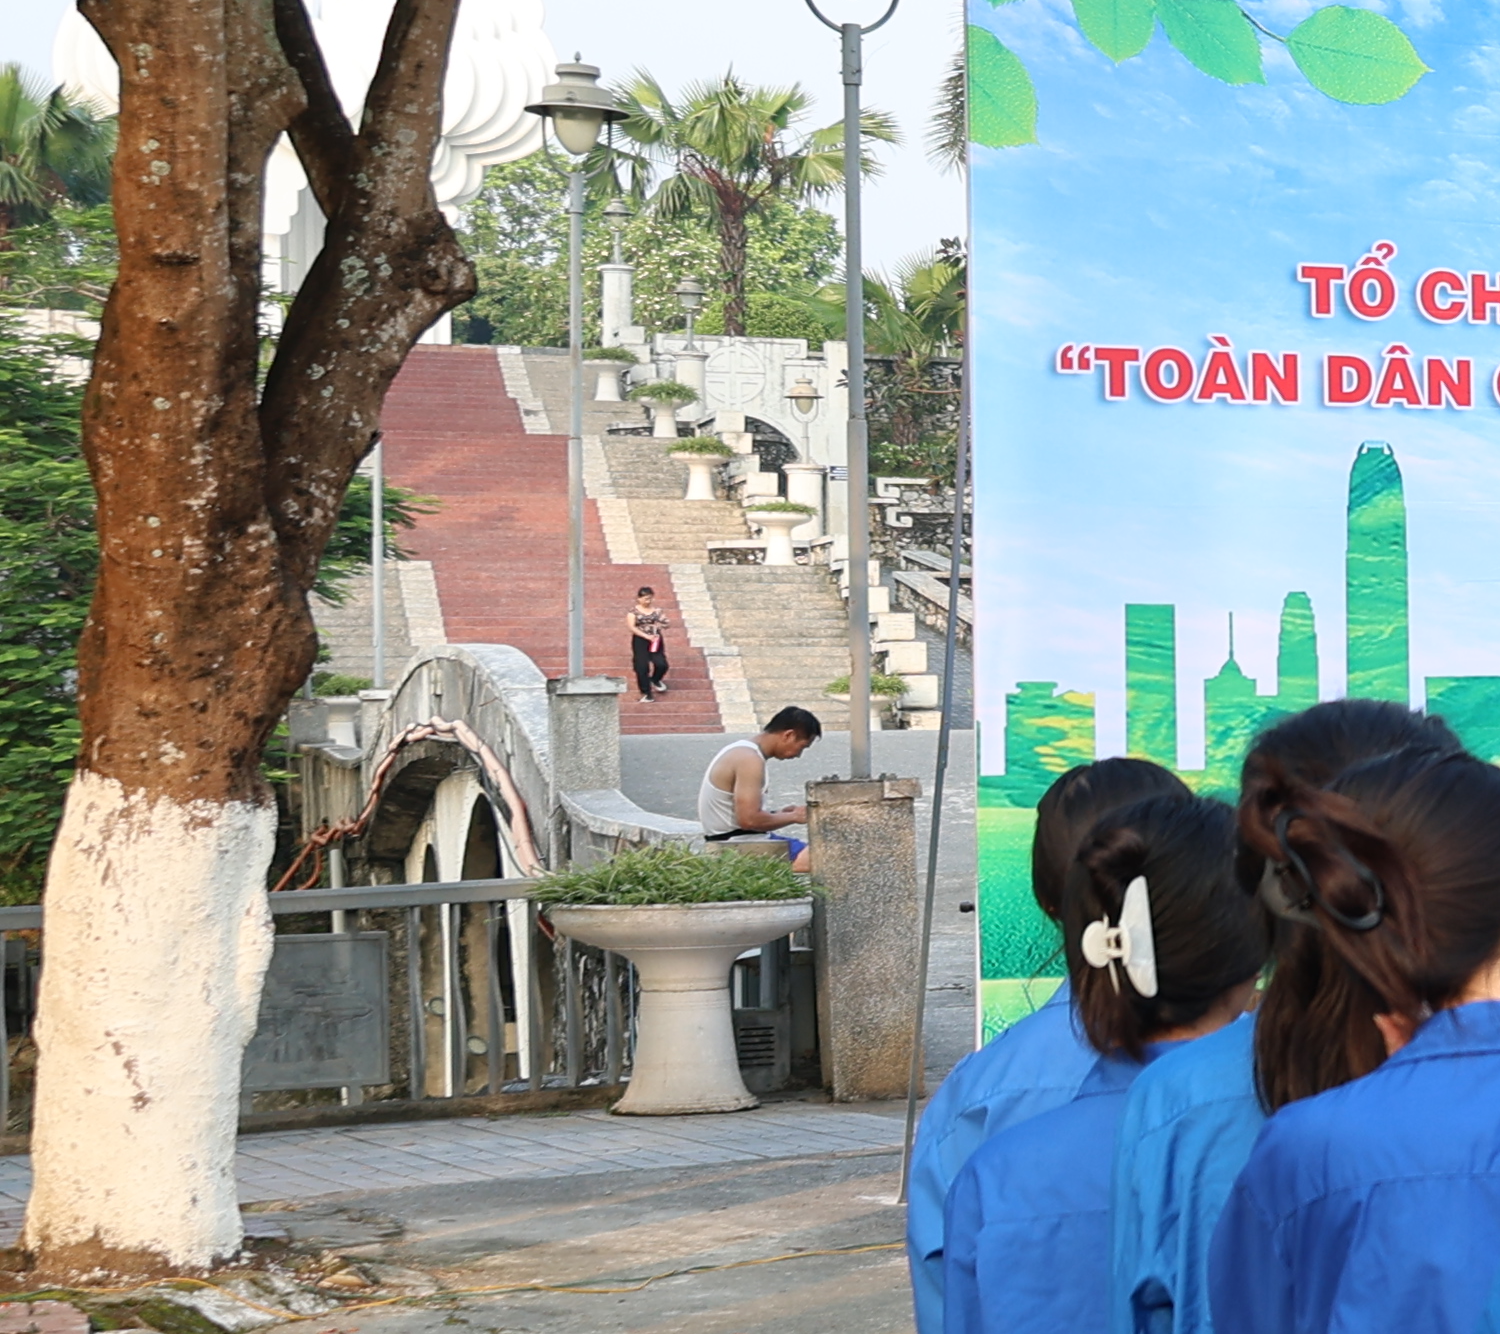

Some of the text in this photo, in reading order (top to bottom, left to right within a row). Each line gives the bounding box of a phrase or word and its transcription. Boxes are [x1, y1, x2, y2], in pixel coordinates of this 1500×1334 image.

[1299, 241, 1398, 320] TỔ
[1058, 334, 1301, 404] “TOÀN
[1325, 343, 1474, 409] DÂN
